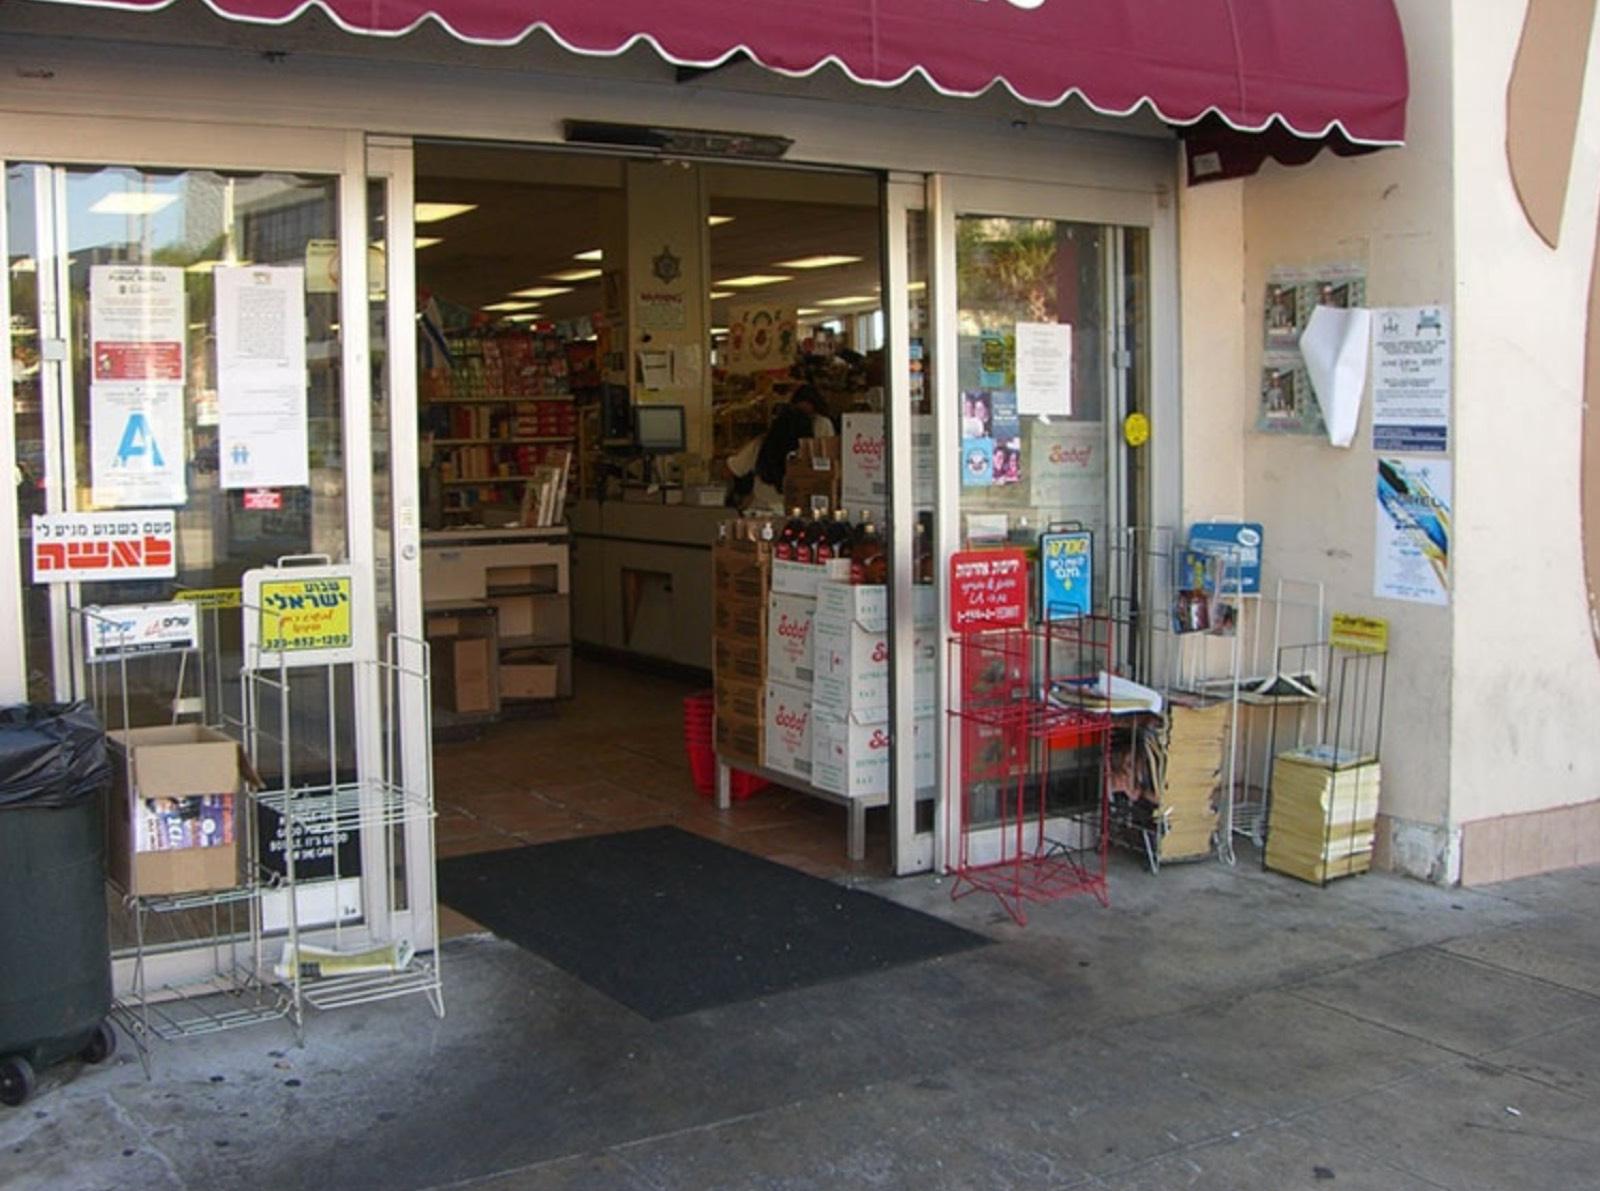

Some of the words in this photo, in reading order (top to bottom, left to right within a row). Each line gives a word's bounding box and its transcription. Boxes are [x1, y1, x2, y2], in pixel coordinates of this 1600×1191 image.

[113, 411, 165, 468] A
[37, 535, 171, 571] לאשה
[265, 592, 347, 610] ישראלי
